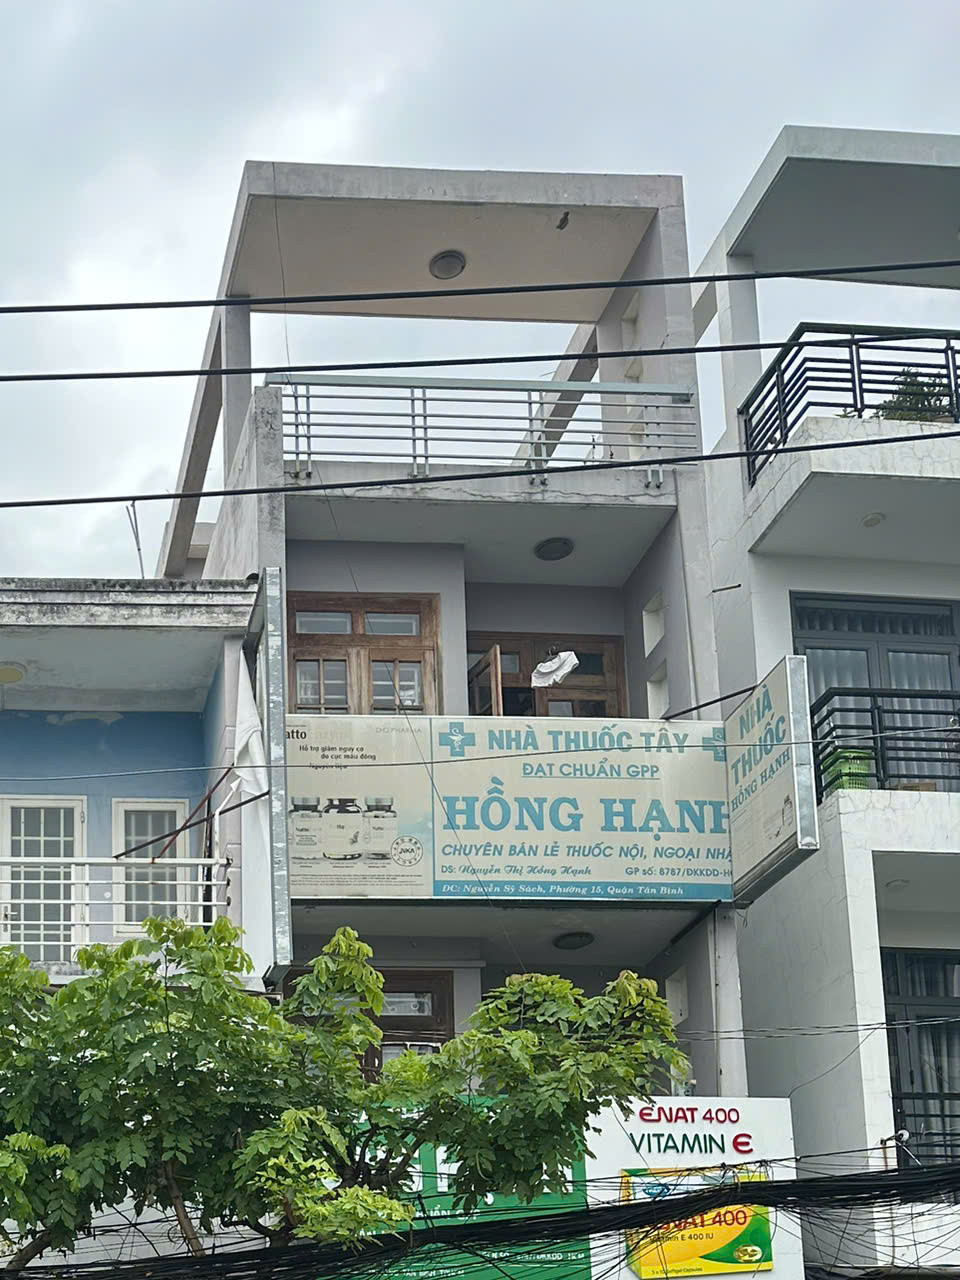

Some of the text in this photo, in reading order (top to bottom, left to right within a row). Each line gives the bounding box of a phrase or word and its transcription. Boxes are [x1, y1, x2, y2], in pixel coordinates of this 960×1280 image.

[738, 683, 773, 740] NHÀ
[286, 729, 307, 740] atto
[488, 724, 689, 753] NHÀ THUỐC TÂY
[731, 711, 787, 786] THUỐC
[559, 757, 621, 777] CHUẨN
[626, 764, 660, 777] GPP
[442, 776, 584, 832] HỒNG
[441, 842, 503, 857] CHUYÊN
[508, 842, 538, 857] BÁN
[566, 842, 614, 858] THUỐC
[618, 844, 647, 861] NỘI,
[653, 846, 700, 861] NGOẠI
[625, 867, 640, 876] GP
[639, 1106, 740, 1125] ENAT 400
[629, 1132, 754, 1155] VITAMIN E
[711, 1210, 747, 1227] 400
[681, 1233, 686, 1242] E
[688, 1233, 705, 1242] 400
